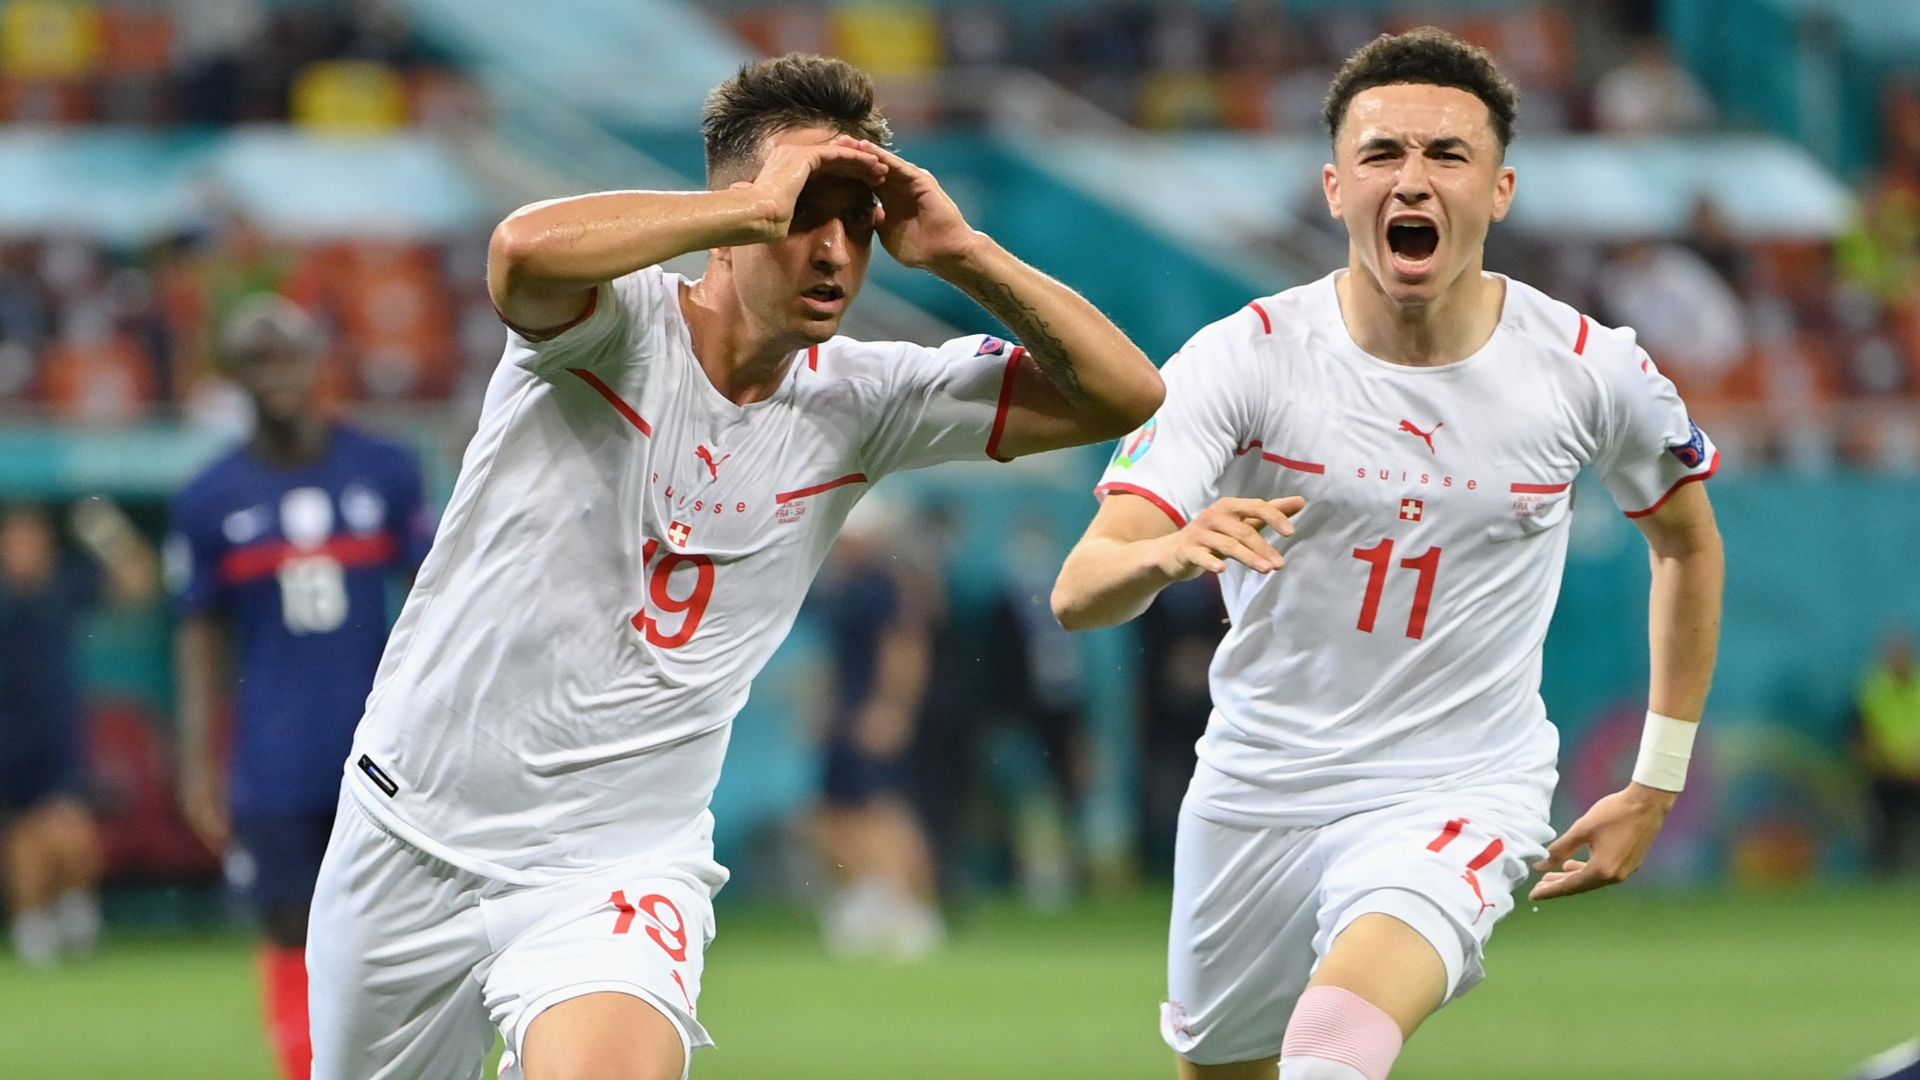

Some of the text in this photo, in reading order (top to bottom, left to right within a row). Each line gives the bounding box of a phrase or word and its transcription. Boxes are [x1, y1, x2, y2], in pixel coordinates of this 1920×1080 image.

[653, 472, 746, 514] suisse
[1356, 467, 1478, 490] suisse
[1352, 538, 1442, 640] 11
[1426, 817, 1504, 871] 11
[611, 890, 687, 962] 19
